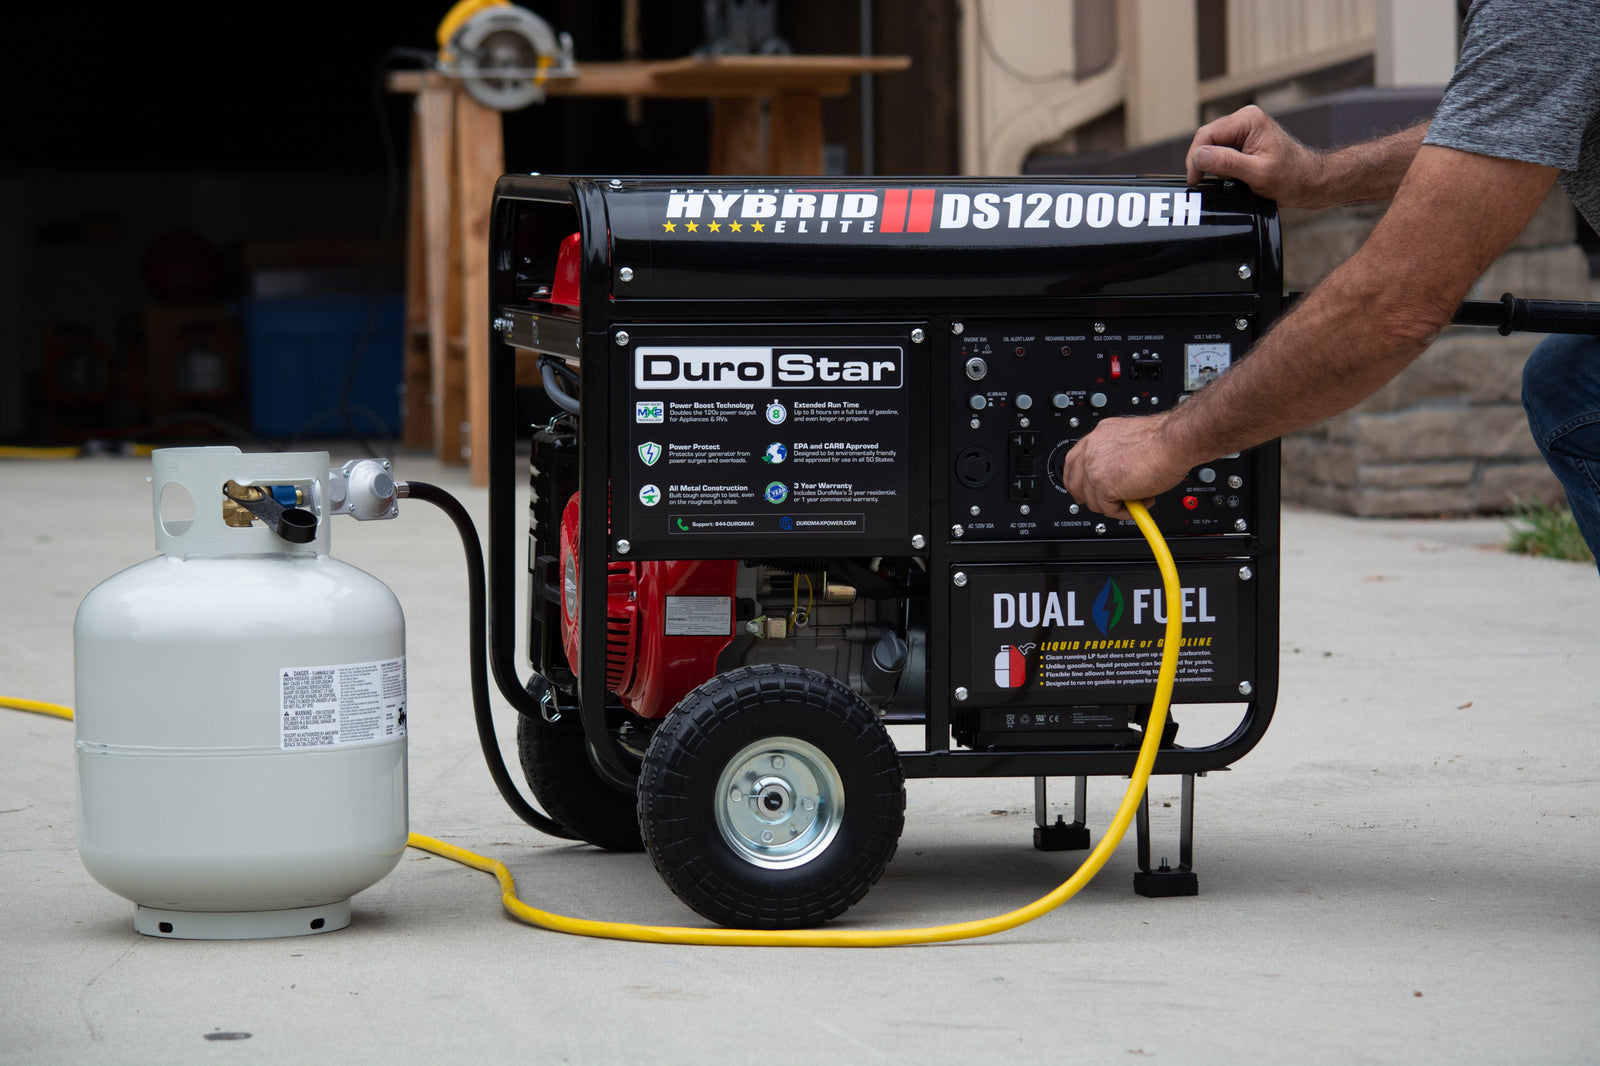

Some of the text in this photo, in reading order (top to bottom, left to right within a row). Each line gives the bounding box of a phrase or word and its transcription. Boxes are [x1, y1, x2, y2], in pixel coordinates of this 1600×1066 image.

[666, 194, 878, 218] HYBRID
[940, 192, 1202, 229] DS12000EH
[774, 220, 874, 233] ELITE
[643, 354, 896, 382] Duro Star
[716, 402, 754, 411] Technology
[772, 410, 780, 418] 8
[818, 483, 853, 491] Warranty
[993, 587, 1216, 629] DUAL FUEL
[1041, 642, 1080, 651] LIQUID
[1084, 640, 1135, 650] PROPANE
[1157, 637, 1212, 647] GOLINE
